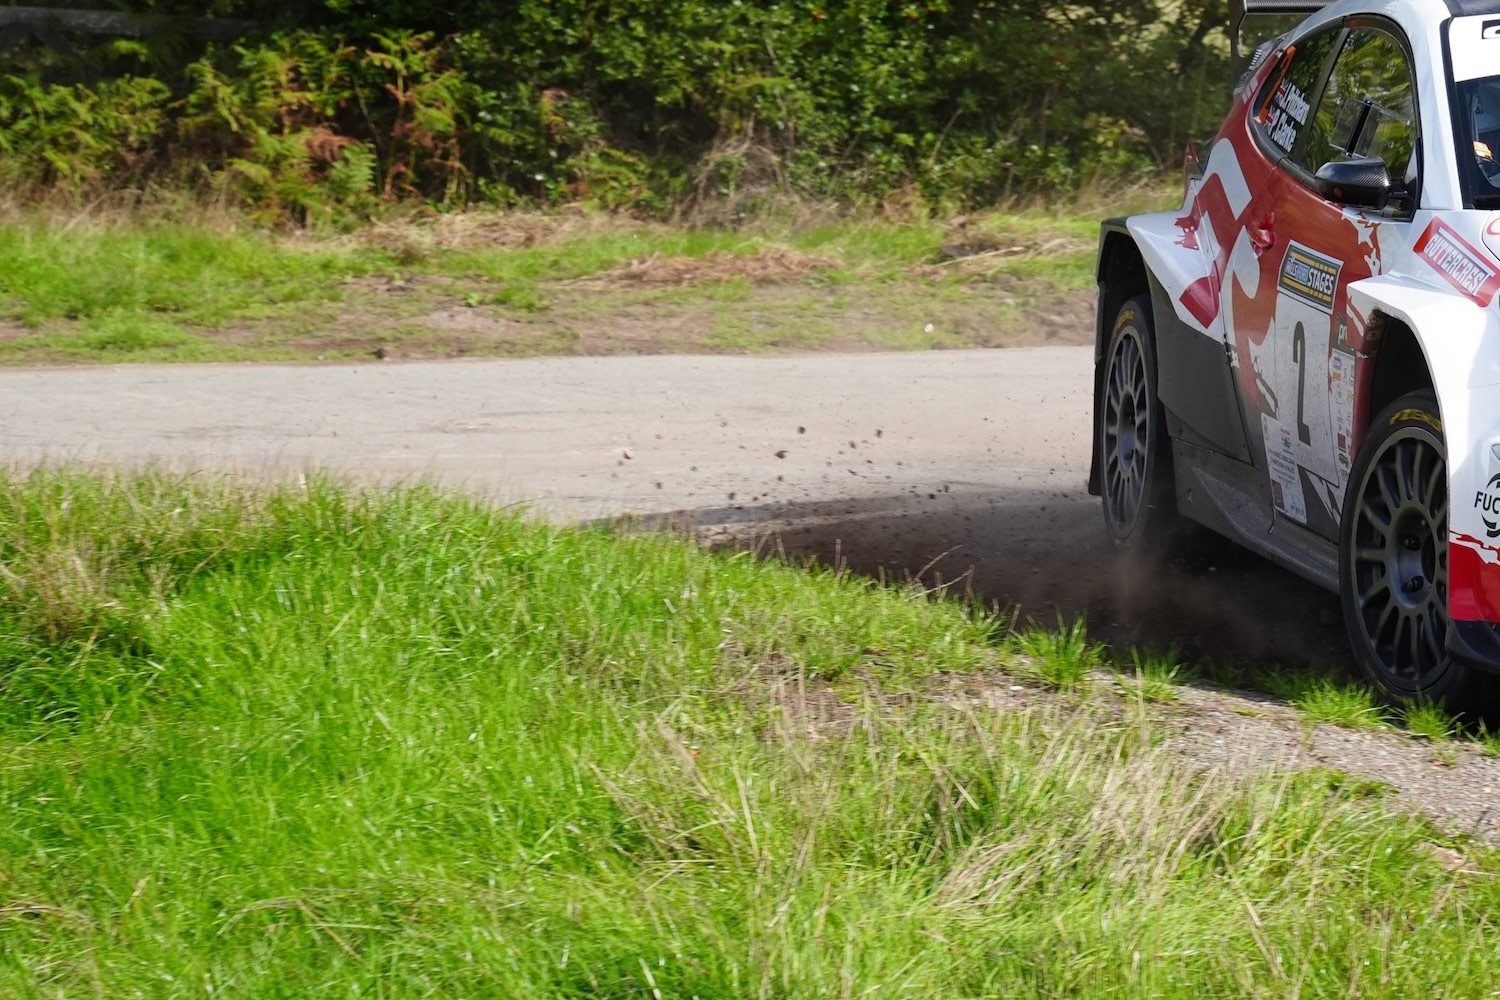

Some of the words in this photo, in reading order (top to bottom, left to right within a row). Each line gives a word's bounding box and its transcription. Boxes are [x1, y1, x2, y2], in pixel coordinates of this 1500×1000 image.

[1307, 267, 1335, 295] STAGES
[1423, 226, 1497, 297] GUTTERCREST
[1293, 320, 1312, 447] 2
